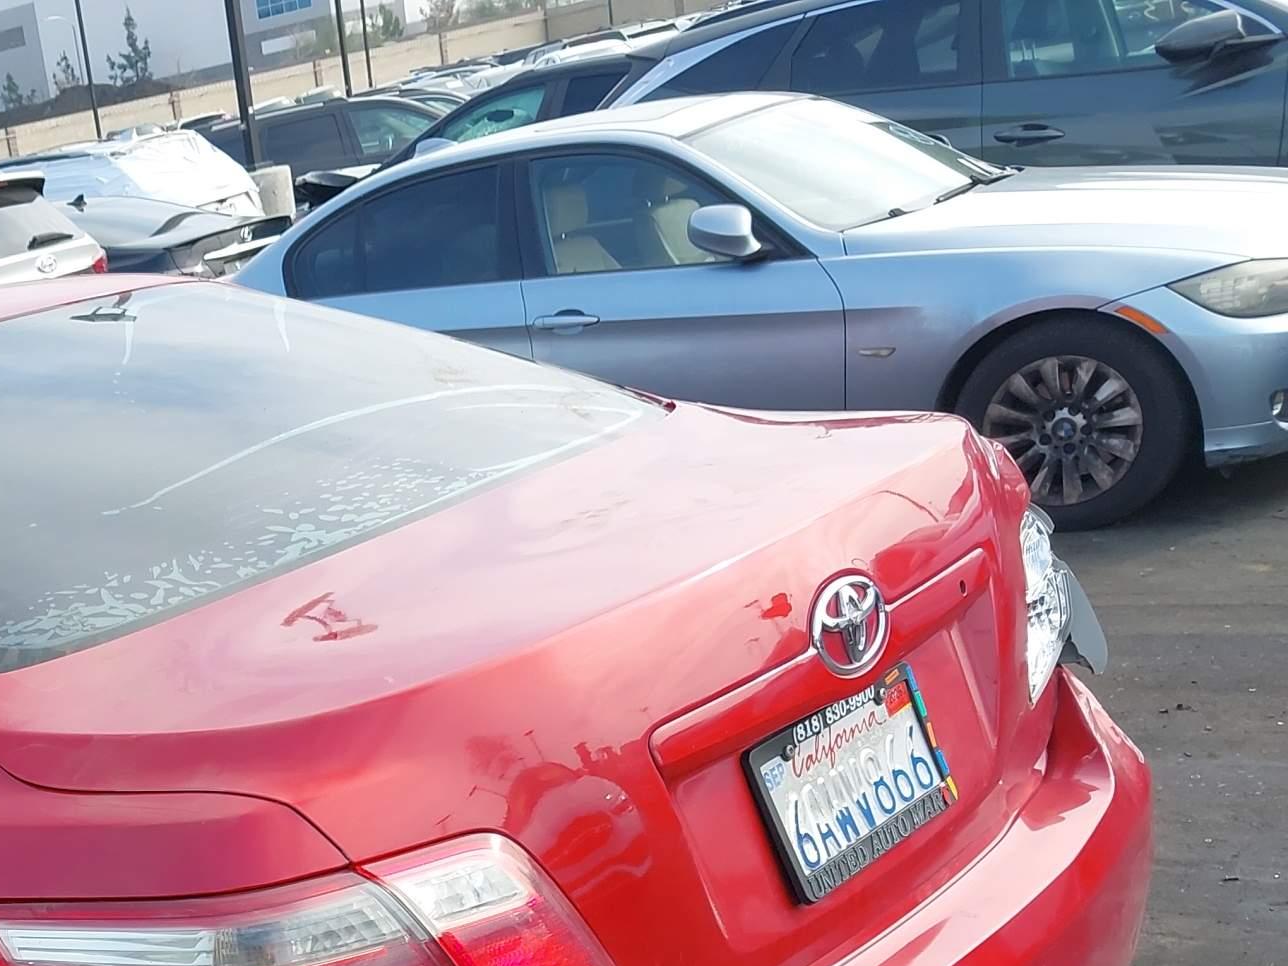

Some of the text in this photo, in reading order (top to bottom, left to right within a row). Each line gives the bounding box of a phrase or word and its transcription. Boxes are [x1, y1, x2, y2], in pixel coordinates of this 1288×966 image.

[792, 710, 887, 778] California
[793, 712, 824, 746] (818)
[825, 685, 875, 724] 830-9900
[807, 842, 872, 900] UNITED
[871, 812, 912, 860] AUTO
